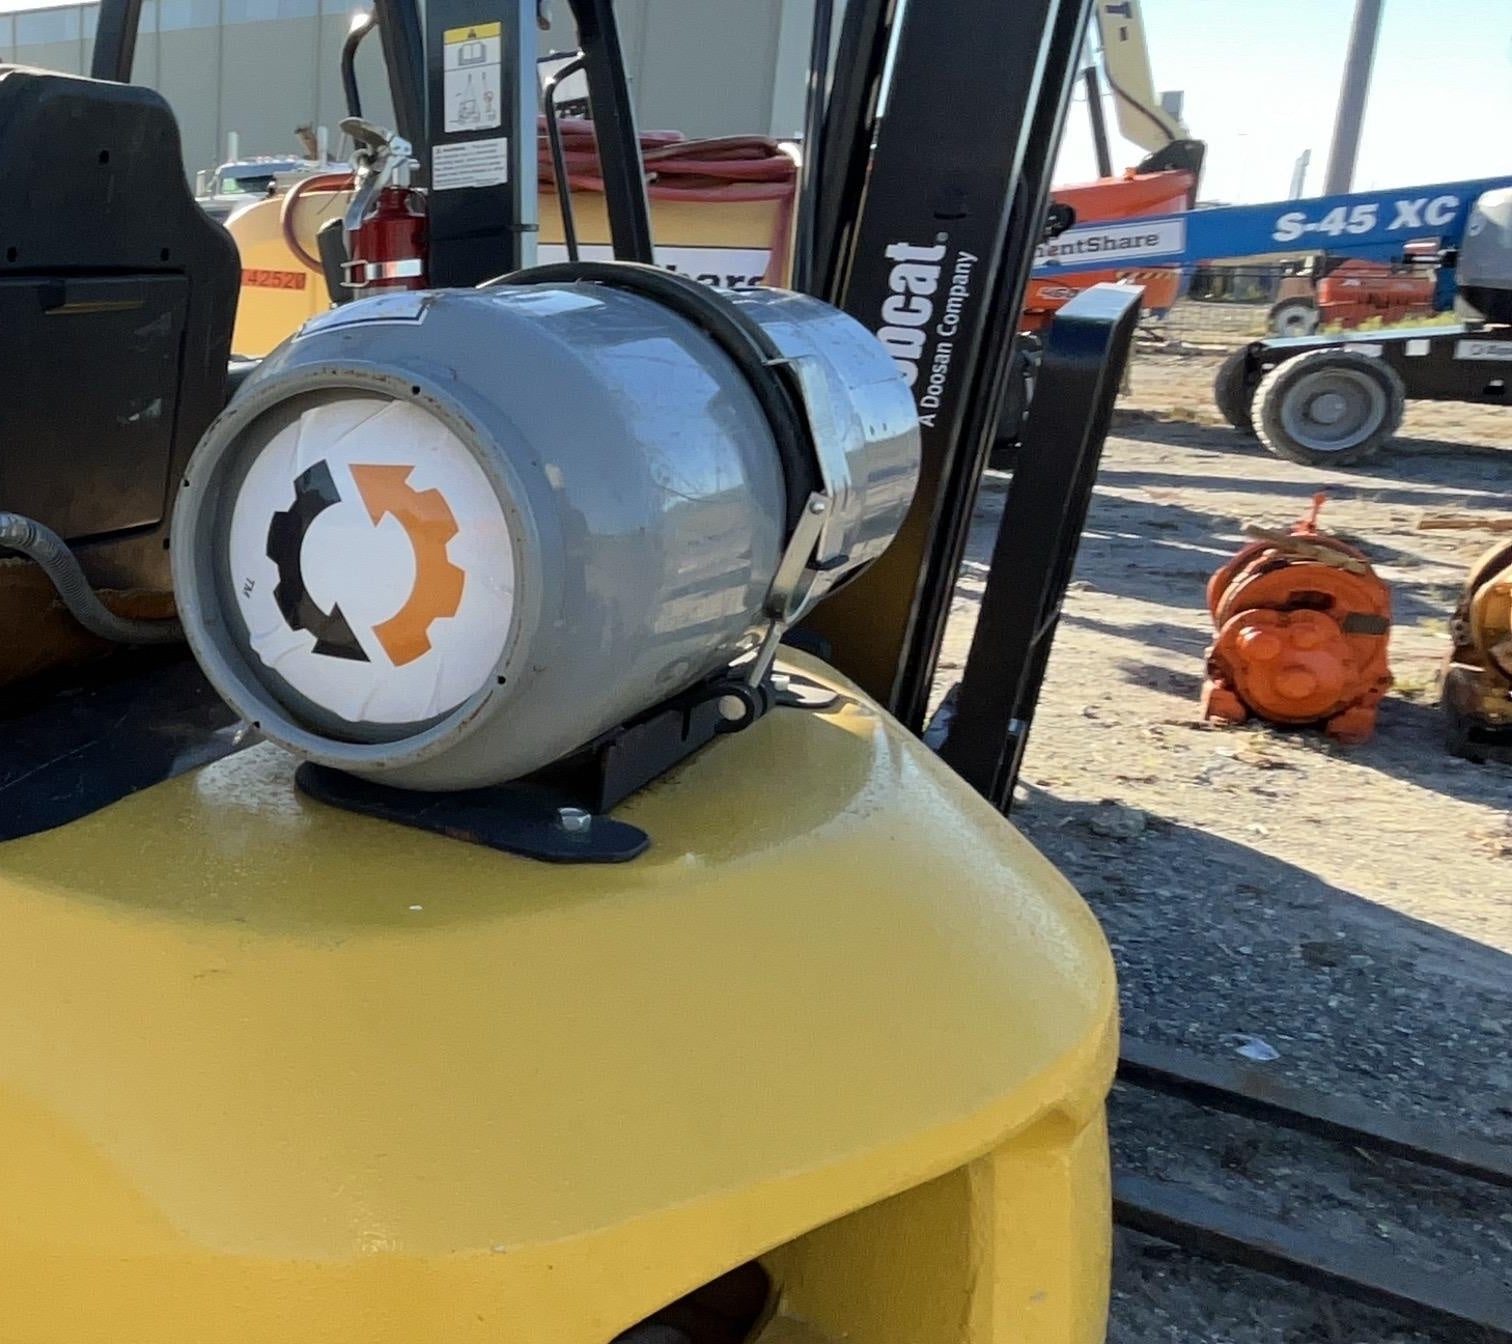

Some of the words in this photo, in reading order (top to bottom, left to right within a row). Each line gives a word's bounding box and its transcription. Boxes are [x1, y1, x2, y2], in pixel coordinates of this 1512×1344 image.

[1271, 202, 1380, 243] S-45
[1385, 194, 1461, 231] XC
[936, 250, 979, 338] Company
[920, 342, 953, 409] Doosan
[918, 412, 937, 428] A
